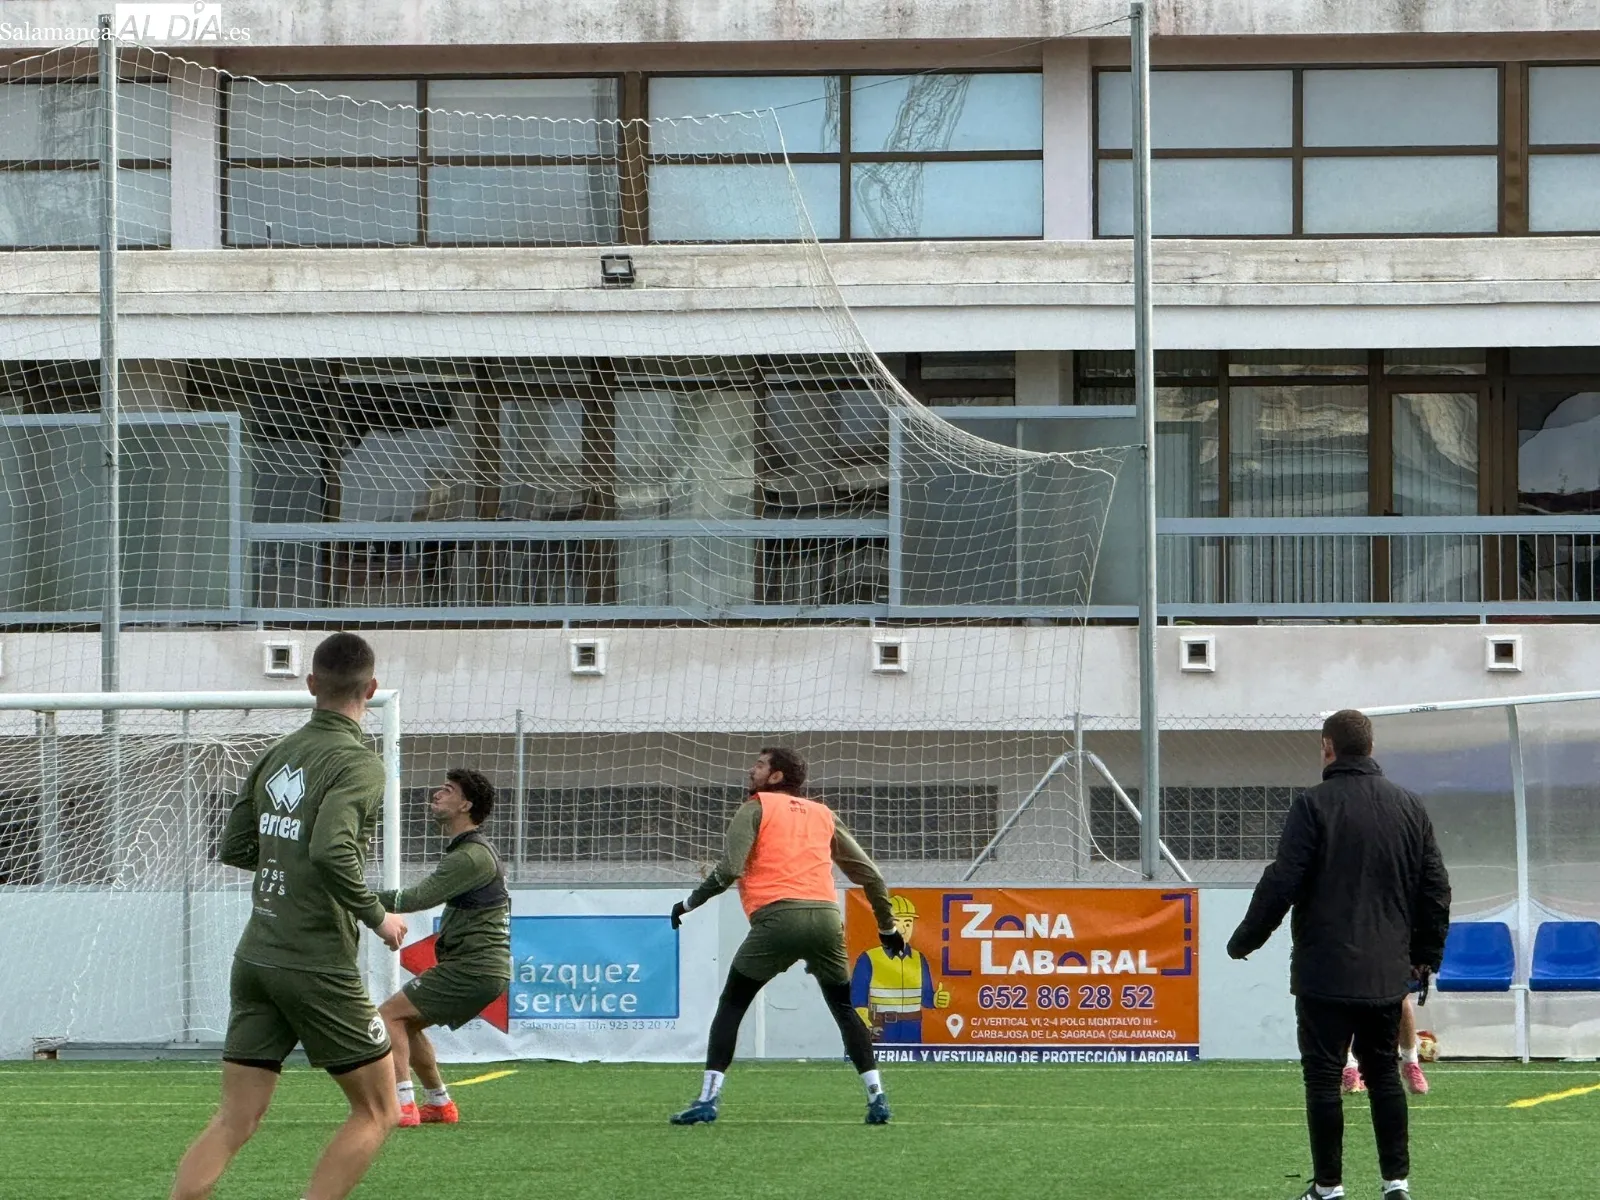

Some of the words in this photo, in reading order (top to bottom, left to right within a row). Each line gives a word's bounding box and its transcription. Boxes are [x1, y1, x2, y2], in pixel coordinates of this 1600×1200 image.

[960, 903, 1074, 939] ZONA
[980, 940, 1158, 976] LABORAL
[509, 955, 641, 989] lázquez
[514, 987, 638, 1013] service
[978, 984, 1028, 1010] 652
[1036, 984, 1070, 1010] 86
[1078, 984, 1112, 1010] 28
[1120, 984, 1155, 1010] 52
[519, 1020, 577, 1030] Salamanca
[609, 1020, 629, 1030] 923
[632, 1020, 645, 1030] 23
[648, 1020, 661, 1030] 20
[970, 1017, 982, 1026] C/
[984, 1017, 1029, 1026] VERTICAL
[1060, 1017, 1086, 1026] POLG
[1088, 1017, 1141, 1026] MONTALVO
[970, 1029, 1029, 1039] CARBAJOSA
[1031, 1029, 1044, 1039] DE
[1046, 1029, 1058, 1039] LA
[1060, 1029, 1106, 1039] SAGRADA
[1108, 1029, 1176, 1040] (SALAMANCA)
[873, 1050, 917, 1062] TERIAL
[920, 1050, 931, 1062] Y
[1042, 1048, 1127, 1063] PROTECCIÓN
[1131, 1050, 1191, 1062] LABORAL
